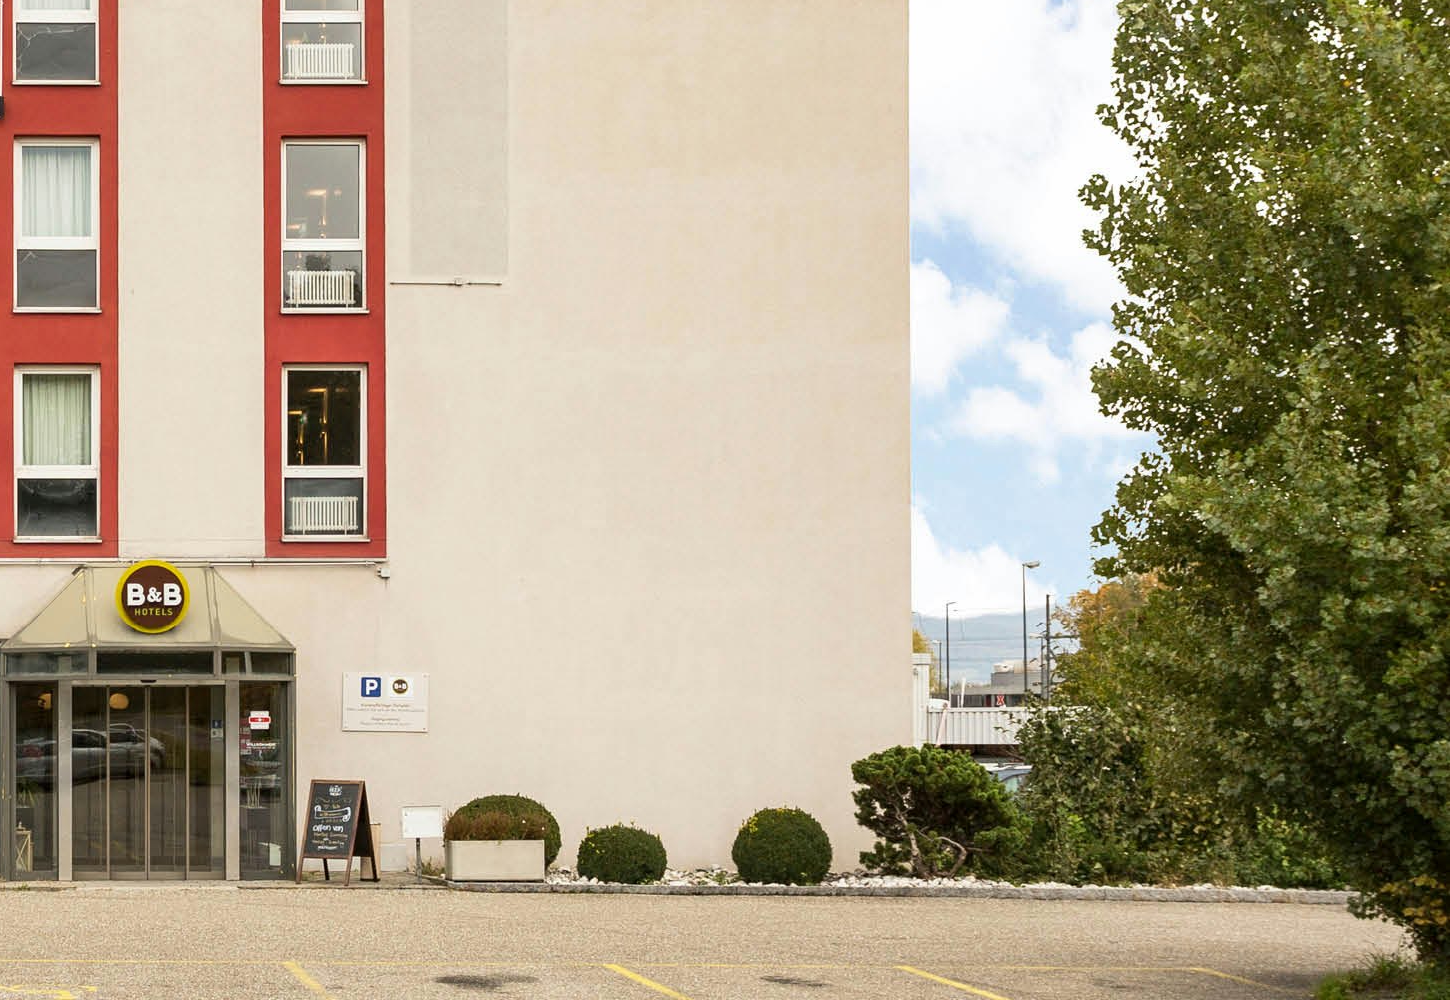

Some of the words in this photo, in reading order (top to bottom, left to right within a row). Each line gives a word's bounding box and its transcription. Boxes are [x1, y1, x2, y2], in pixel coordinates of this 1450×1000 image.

[127, 583, 182, 606] B&B
[134, 608, 173, 616] HOTELS
[365, 679, 378, 695] P
